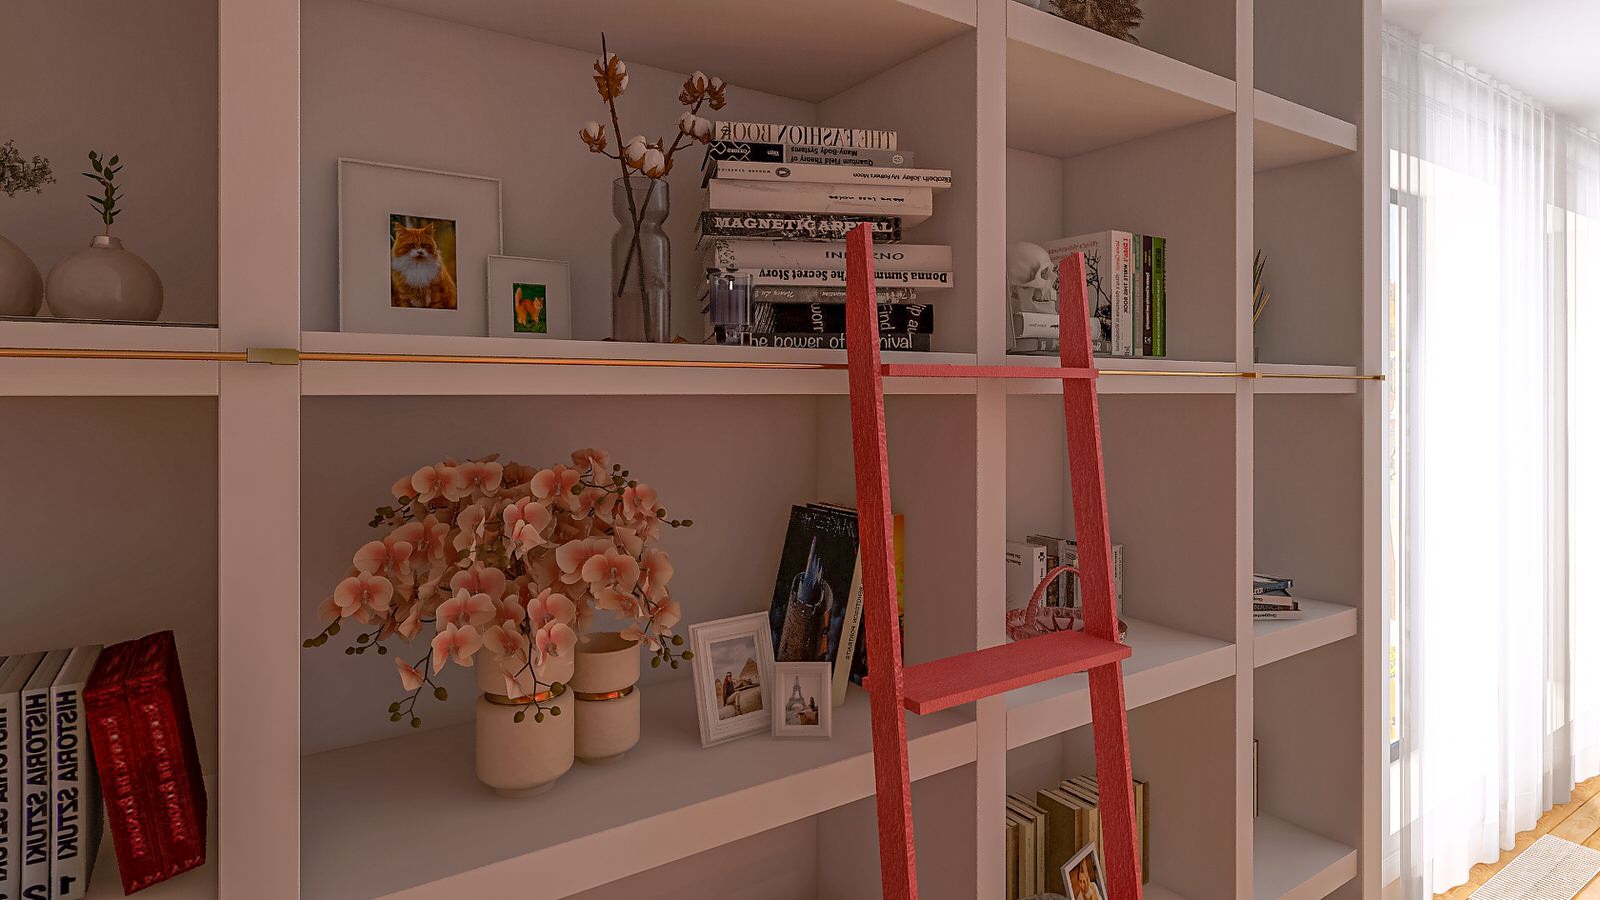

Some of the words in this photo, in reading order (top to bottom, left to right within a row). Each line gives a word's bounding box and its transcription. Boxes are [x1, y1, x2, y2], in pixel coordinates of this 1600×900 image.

[791, 146, 818, 156] Systems
[819, 147, 858, 157] Many-Body
[790, 155, 797, 164] of
[798, 155, 823, 165] Theory
[824, 156, 841, 165] Field
[841, 157, 874, 166] Quantum
[759, 268, 790, 281] Story
[792, 269, 828, 281] Secret
[911, 272, 947, 284] Donna
[829, 334, 846, 349] of
